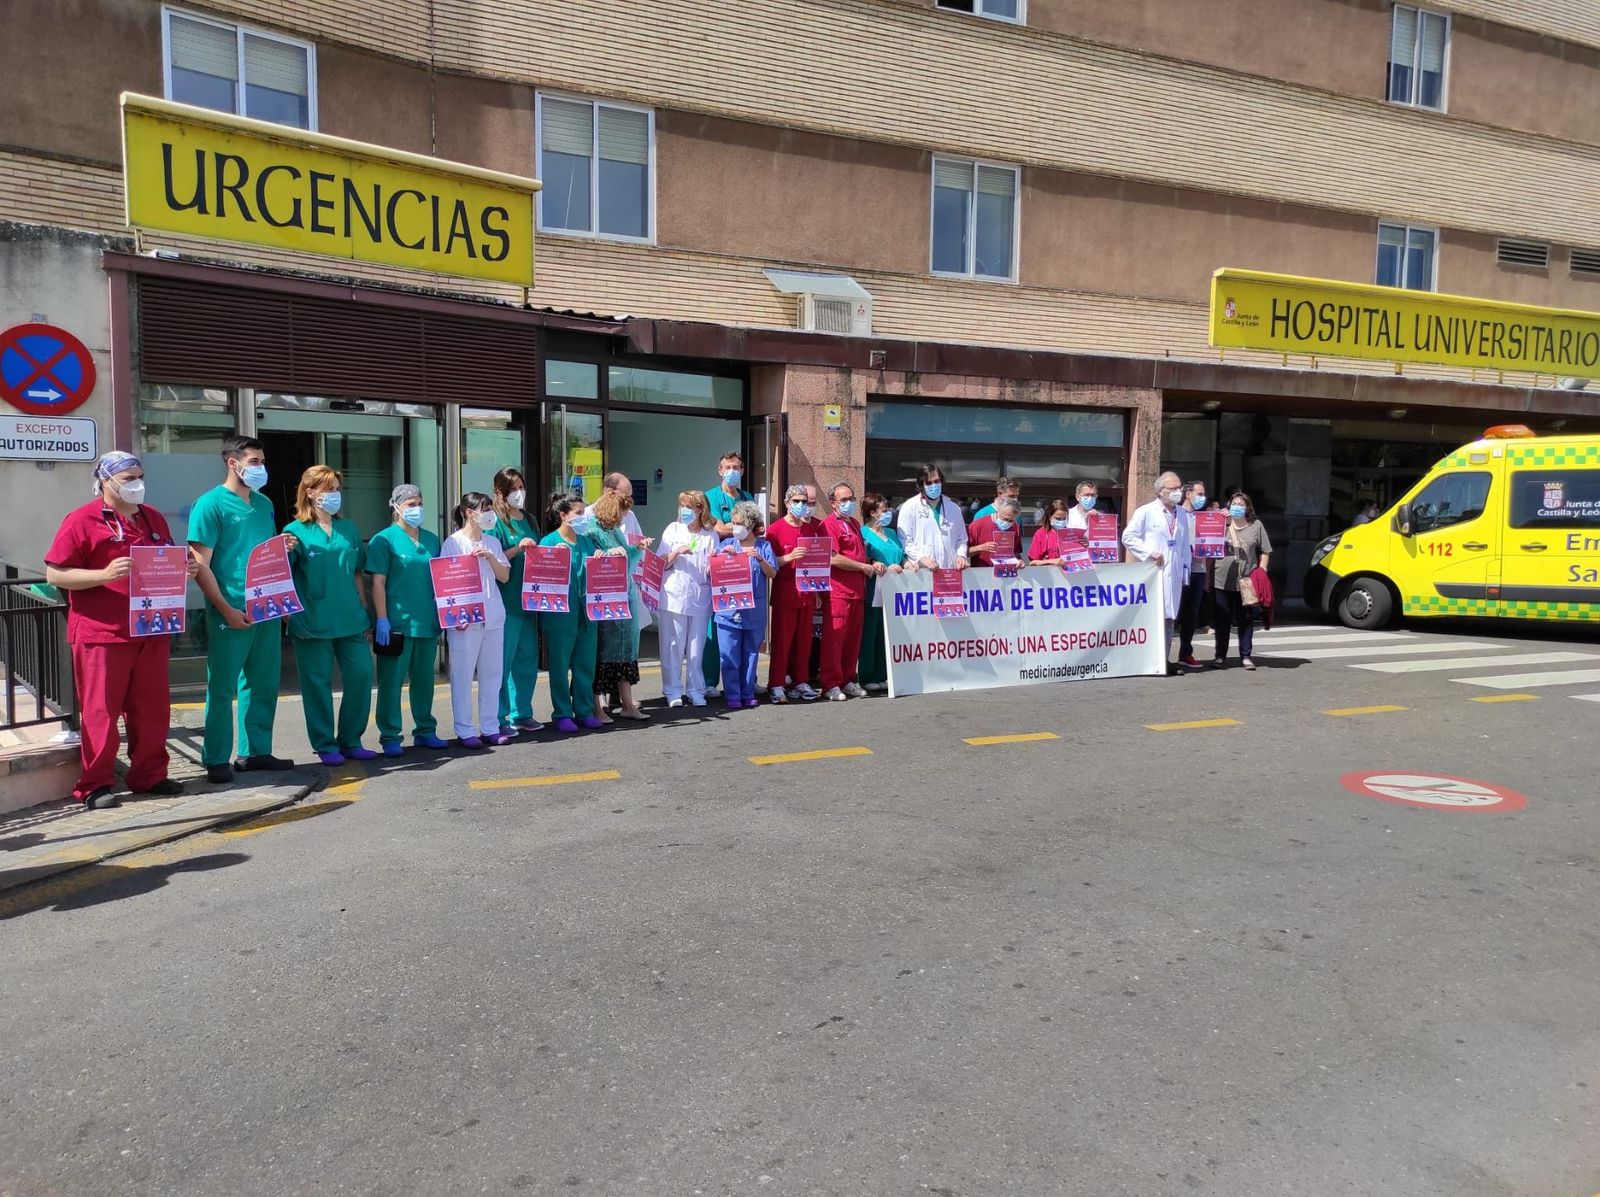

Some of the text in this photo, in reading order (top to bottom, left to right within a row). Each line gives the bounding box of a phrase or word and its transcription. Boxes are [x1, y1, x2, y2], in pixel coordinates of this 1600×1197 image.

[161, 143, 511, 262] URGENCIAS
[1270, 297, 1600, 367] HOSPITAL UNIVERSITARIO
[16, 423, 72, 435] EXCEPTO
[0, 438, 90, 453] AUTORIZADOS
[1537, 508, 1572, 517] Castilla
[1573, 510, 1581, 518] y
[1564, 500, 1592, 508] Junta
[1428, 542, 1453, 557] 112
[894, 582, 1148, 617] MEINA DE URGENCIA
[893, 628, 1147, 663] UNA PROFESIÓN: UNA ESPECIALIDAD
[1019, 659, 1109, 680] medicinadeurgencia
